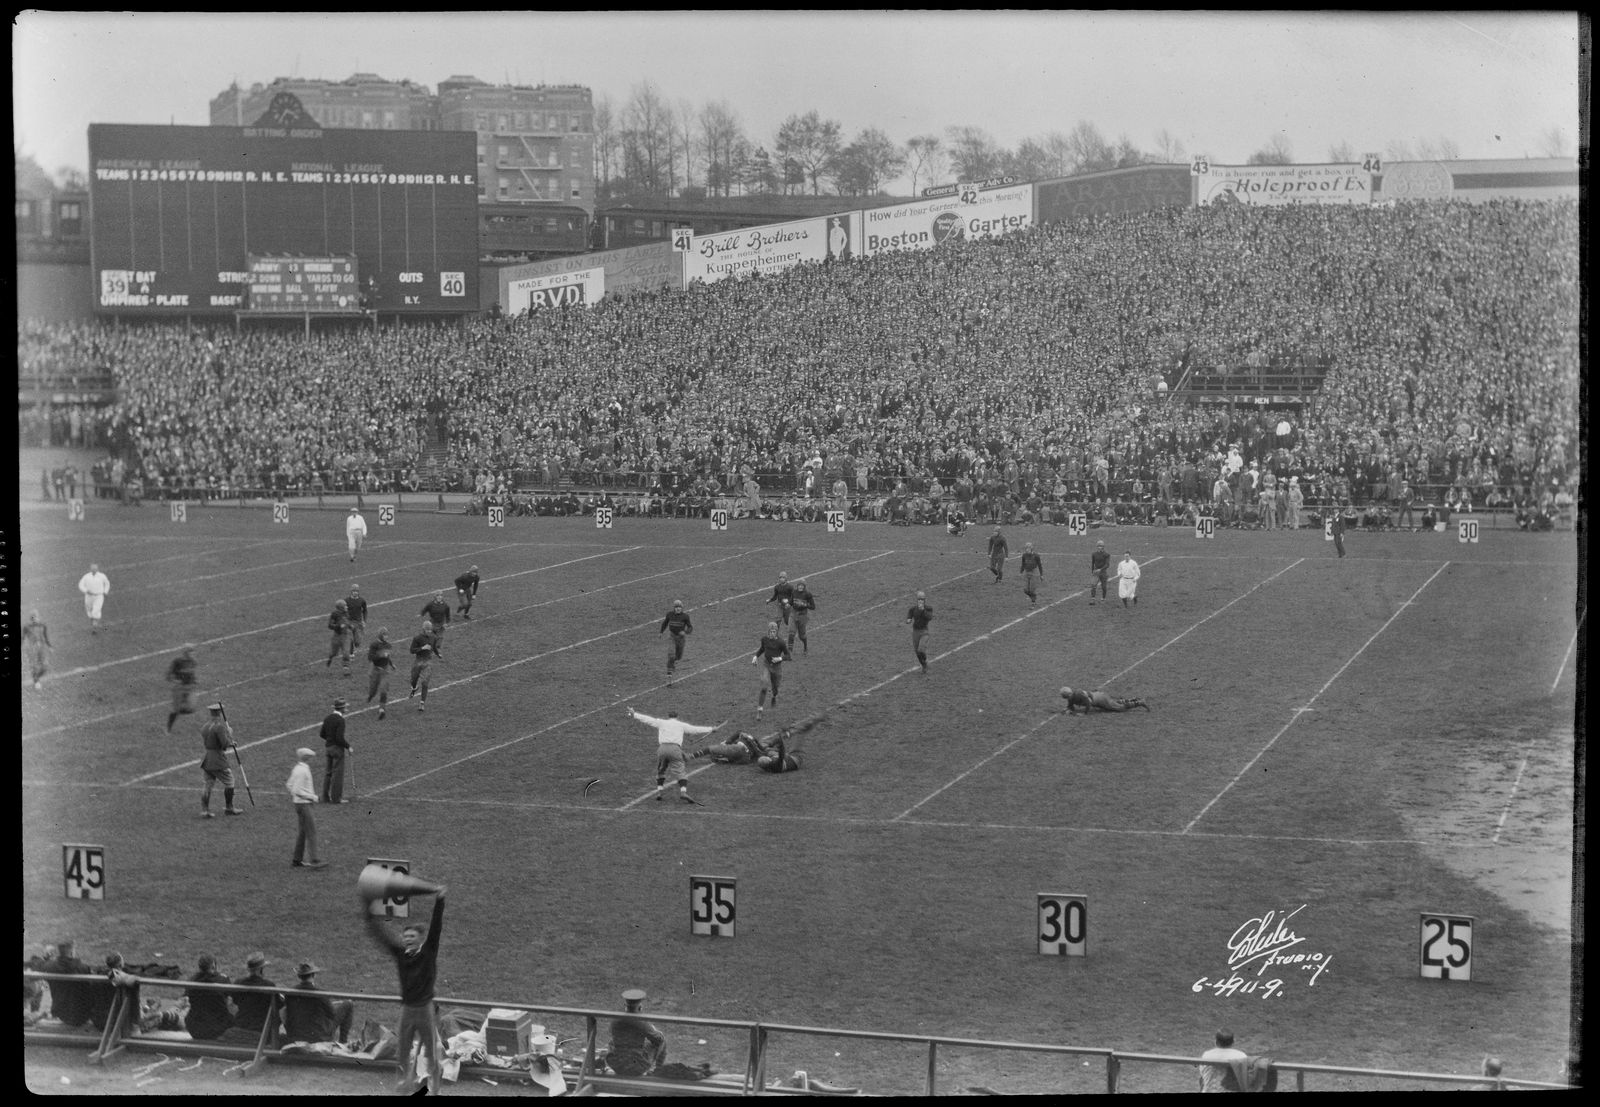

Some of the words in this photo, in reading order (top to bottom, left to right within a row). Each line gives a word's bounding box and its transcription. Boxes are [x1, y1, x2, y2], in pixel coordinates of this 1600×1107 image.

[97, 159, 152, 169] AMERICAN
[158, 159, 202, 170] LEAGUE
[291, 162, 337, 172] NATIONAL
[343, 163, 385, 173] LEAGUE
[1191, 161, 1209, 174] 43
[1362, 159, 1381, 172] 44
[292, 173, 324, 183] TEAMS
[326, 174, 331, 183] 1
[334, 174, 342, 184] 2
[343, 174, 351, 184] 3
[352, 174, 360, 184] 4
[361, 174, 370, 184] 5
[370, 174, 378, 184] 6
[380, 174, 388, 184] 7
[388, 174, 397, 184] 8
[398, 174, 406, 184] 9
[436, 175, 447, 184] R.
[450, 175, 461, 184] H.
[464, 175, 475, 184] E.
[1279, 168, 1295, 176] and
[1298, 168, 1312, 179] get
[1325, 167, 1342, 176] box
[1345, 167, 1355, 175] of
[926, 185, 956, 197] General
[1235, 176, 1342, 194] Holeproof
[1344, 176, 1367, 192] Ex
[960, 191, 978, 204] 42
[869, 212, 892, 222] How
[894, 208, 906, 218] did
[968, 212, 1028, 234] Garter
[674, 236, 691, 250] 41
[700, 235, 741, 258] Brill
[747, 228, 809, 251] Brothers
[868, 230, 929, 251] Boston
[565, 259, 584, 270] ON
[590, 253, 620, 266] THIS
[625, 245, 664, 259] LABEL
[706, 251, 801, 275] Kuppenheimer
[252, 262, 279, 272] ARMY
[136, 270, 157, 283] BAT
[306, 274, 332, 283] YARDS
[332, 274, 342, 283] TO
[343, 274, 354, 283] GO
[399, 272, 424, 283] OUTS
[518, 280, 542, 290] MADE
[550, 275, 568, 285] FOR
[574, 271, 591, 281] THE
[105, 278, 126, 294] 39
[443, 280, 463, 294] 40
[156, 294, 189, 306] PLATE
[1199, 395, 1253, 403] EXIT
[1254, 397, 1270, 405] MEN
[1272, 395, 1311, 403] EXI
[173, 502, 185, 518] 15
[275, 505, 288, 519] 20
[379, 507, 394, 521] 25
[489, 508, 503, 523] 30
[597, 509, 612, 524] 35
[711, 511, 726, 527] 40
[829, 513, 844, 528] 45
[1069, 516, 1086, 532] 45
[1197, 518, 1213, 534] 40
[1460, 522, 1478, 538] 30
[66, 849, 104, 889] 45
[693, 880, 735, 924] 35
[1041, 900, 1086, 944] 30
[1422, 918, 1470, 968] 25
